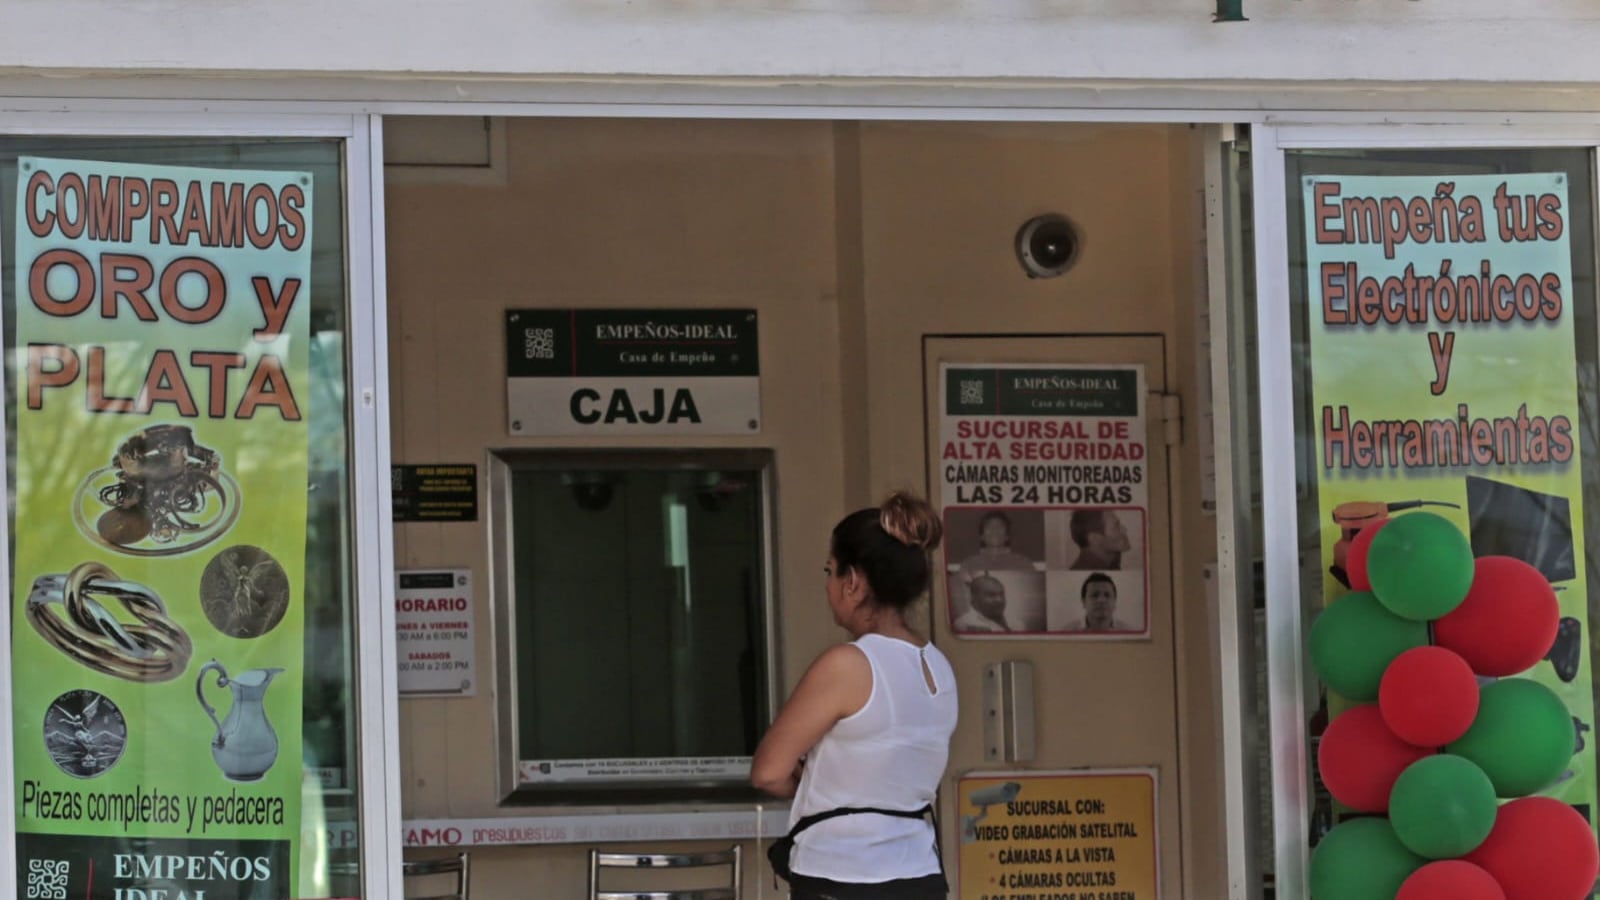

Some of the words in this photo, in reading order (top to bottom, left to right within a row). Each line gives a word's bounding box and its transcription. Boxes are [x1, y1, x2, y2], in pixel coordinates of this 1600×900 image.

[25, 169, 306, 252] COMPRAMOS
[1313, 182, 1486, 259] Empeña
[1493, 181, 1563, 242] tus
[28, 248, 228, 325] ORO
[251, 276, 302, 342] y
[1320, 259, 1562, 325] Electrónicos
[595, 322, 738, 339] EMPEÑOS-IDEAL
[619, 351, 648, 363] Casa
[652, 352, 665, 363] de
[670, 351, 716, 365] Empeño
[1428, 331, 1455, 396] y
[27, 342, 302, 421] PLATA
[1014, 376, 1120, 391] EMPEÑOS-IDEAL
[569, 388, 702, 424] CAJA
[957, 421, 1089, 440] SUCURSAL
[1098, 421, 1129, 440] DE
[1322, 402, 1575, 469] Herramientas
[943, 442, 1001, 460] ALTA
[1010, 443, 1145, 461] SEGURIDAD
[945, 462, 1019, 484] CÁMARAS
[1023, 465, 1142, 484] MONITOREADAS
[956, 486, 1002, 504] LAS
[1011, 486, 1039, 504] 24
[1047, 486, 1133, 504] HORAS
[22, 780, 82, 820] Piezas
[87, 785, 180, 832] completas
[186, 800, 198, 833] y
[202, 788, 284, 833] pedacera
[1007, 800, 1072, 816] SUCURSAL
[1075, 799, 1105, 815] CON:
[975, 825, 1008, 840] VIDEO
[1012, 821, 1077, 840] GRABACIÓN
[1080, 823, 1137, 838] SATELITAL
[113, 850, 271, 881] EMPEÑOS
[998, 847, 1052, 864] CÁMARAS
[1055, 848, 1063, 863] A
[1066, 848, 1080, 863] LA
[1083, 847, 1115, 862] VISTA
[999, 874, 1006, 888] 4
[1009, 870, 1063, 888] CÁMARAS
[1066, 872, 1116, 886] OCULTAS
